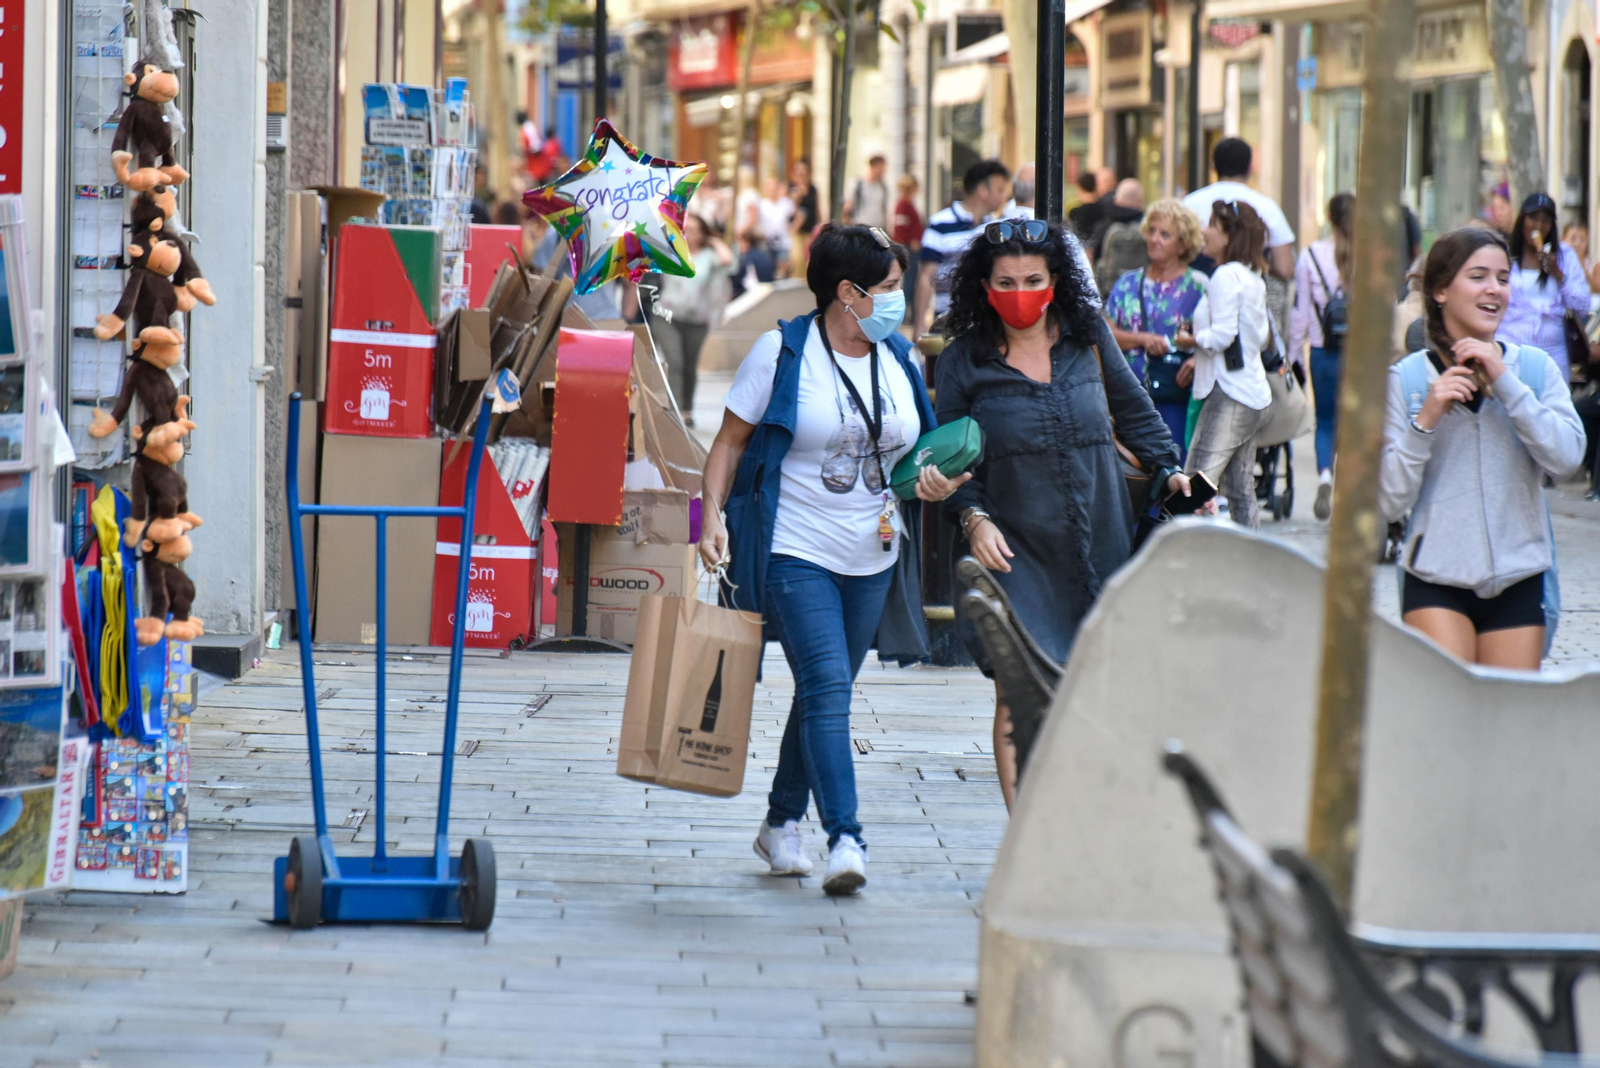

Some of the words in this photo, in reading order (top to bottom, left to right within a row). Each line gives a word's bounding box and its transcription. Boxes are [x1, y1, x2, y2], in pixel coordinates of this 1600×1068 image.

[574, 166, 673, 220] congrats!
[364, 349, 392, 369] 5m
[468, 562, 495, 581] 5m
[50, 770, 75, 882] GIBRALTAR
